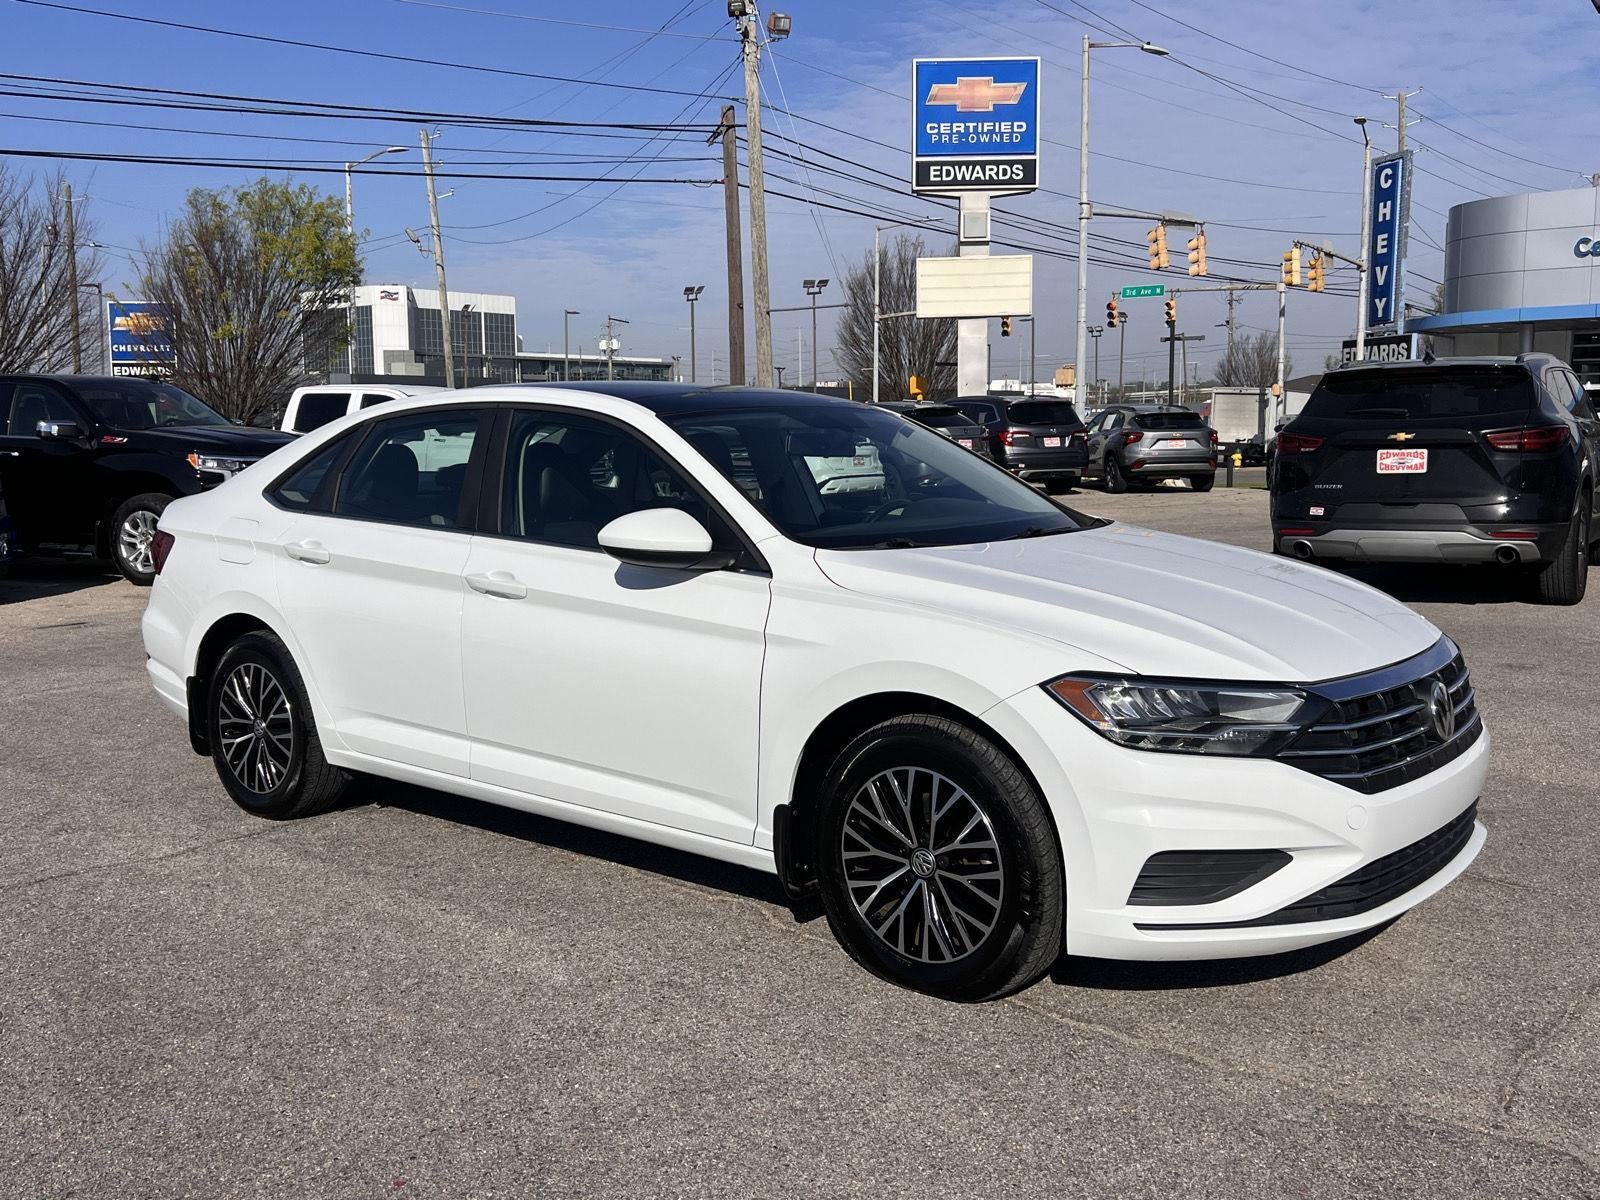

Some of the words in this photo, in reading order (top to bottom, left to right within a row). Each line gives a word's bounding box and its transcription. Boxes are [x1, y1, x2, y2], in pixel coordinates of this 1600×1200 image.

[926, 121, 1027, 134] CERTIFIED
[931, 133, 1021, 144] PRE-OWNED
[929, 164, 1024, 181] EDWARDS
[1374, 167, 1393, 318] CHEVY
[1379, 451, 1425, 461] EDWARDS
[1379, 462, 1425, 471] CHEVYMAN
